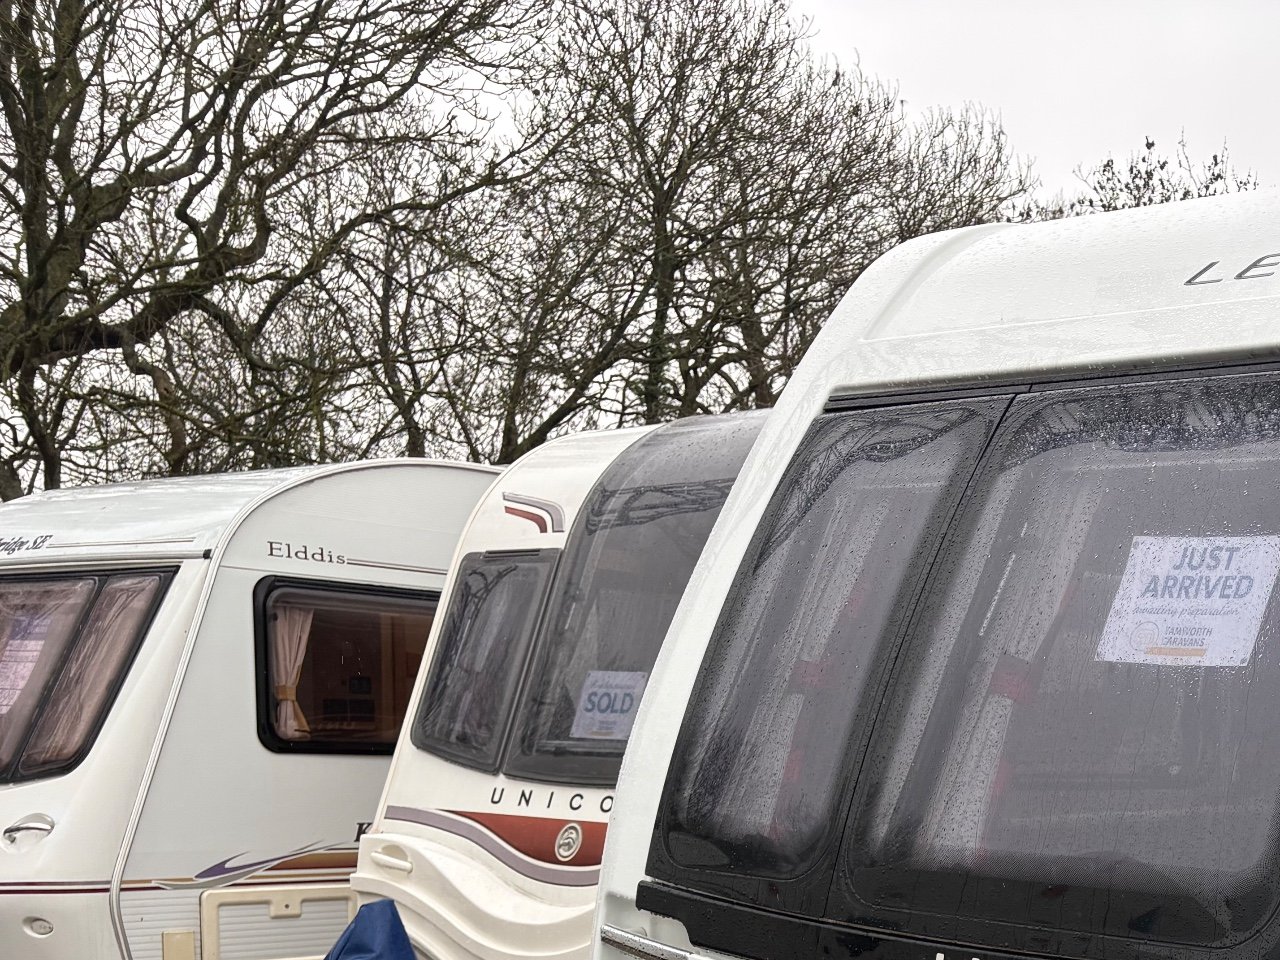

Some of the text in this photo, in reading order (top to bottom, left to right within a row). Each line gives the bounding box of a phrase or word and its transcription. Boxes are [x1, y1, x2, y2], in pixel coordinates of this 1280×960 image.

[267, 541, 346, 564] Elddis
[1172, 546, 1240, 571] JUST
[1140, 575, 1254, 599] ARRIVED
[583, 691, 634, 713] SOLD
